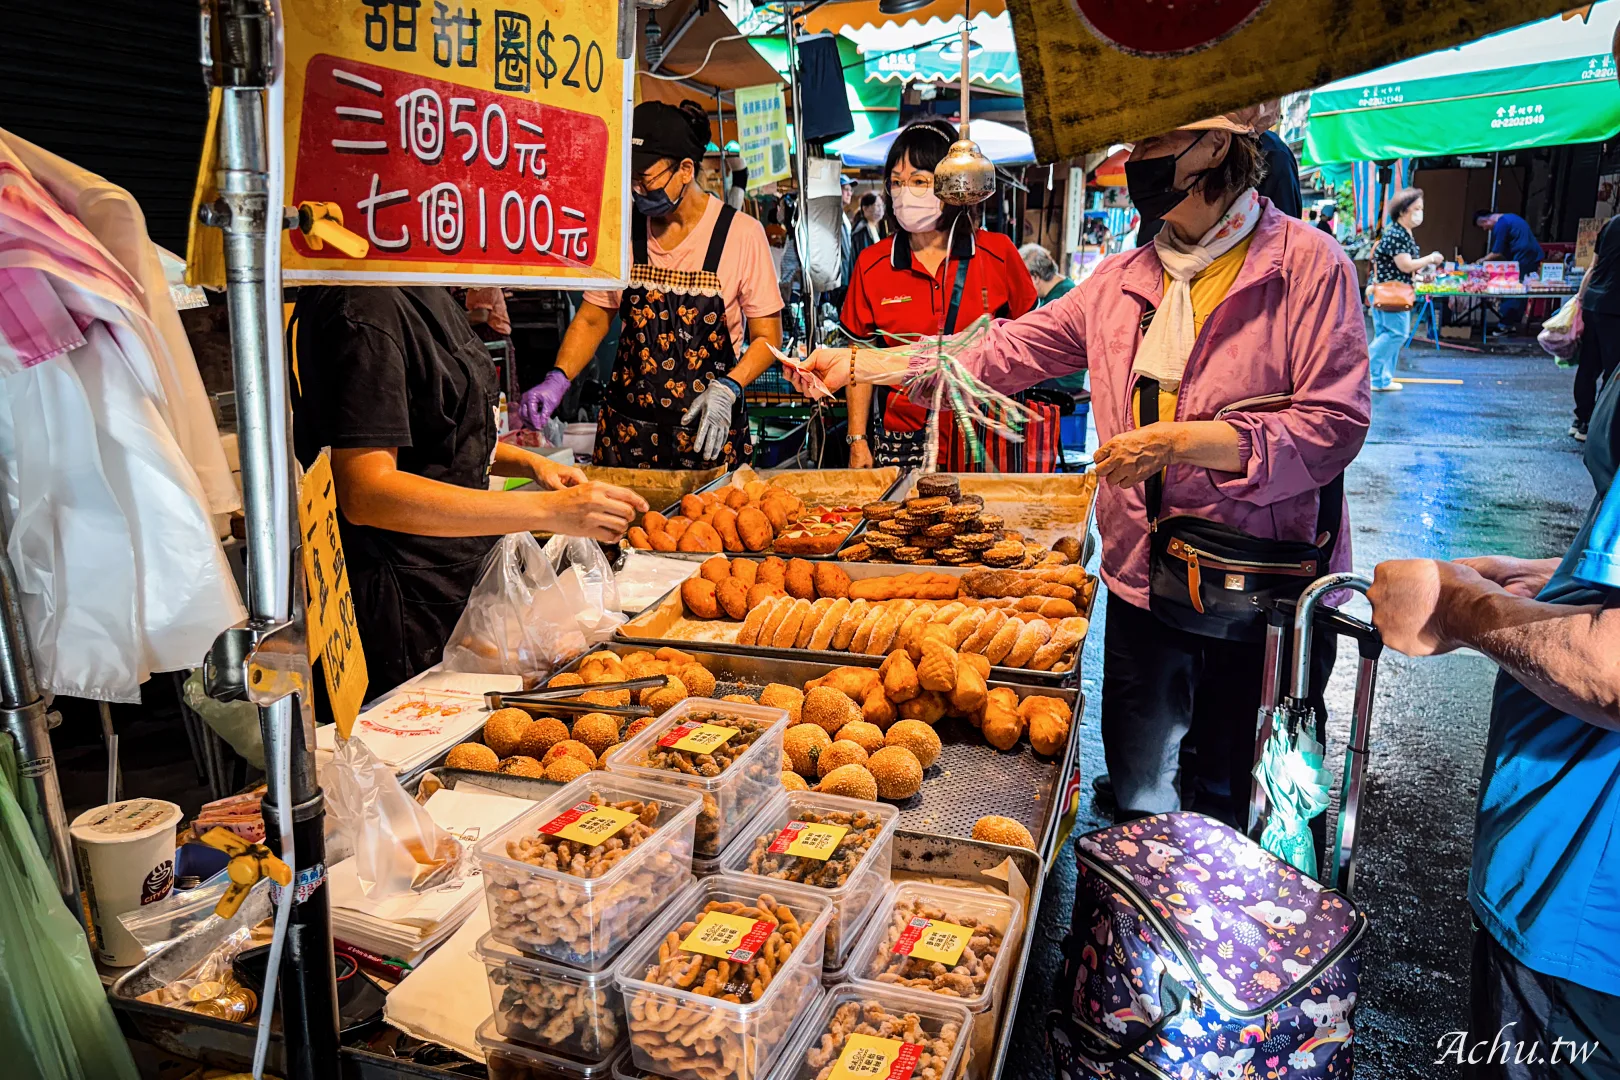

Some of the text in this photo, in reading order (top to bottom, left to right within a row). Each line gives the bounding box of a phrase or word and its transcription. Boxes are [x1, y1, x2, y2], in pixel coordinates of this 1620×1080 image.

[361, 0, 604, 93] 甜甜圈$20
[331, 68, 547, 178] 三個50元
[357, 173, 589, 259] 七個100元
[144, 890, 161, 903] CITY
